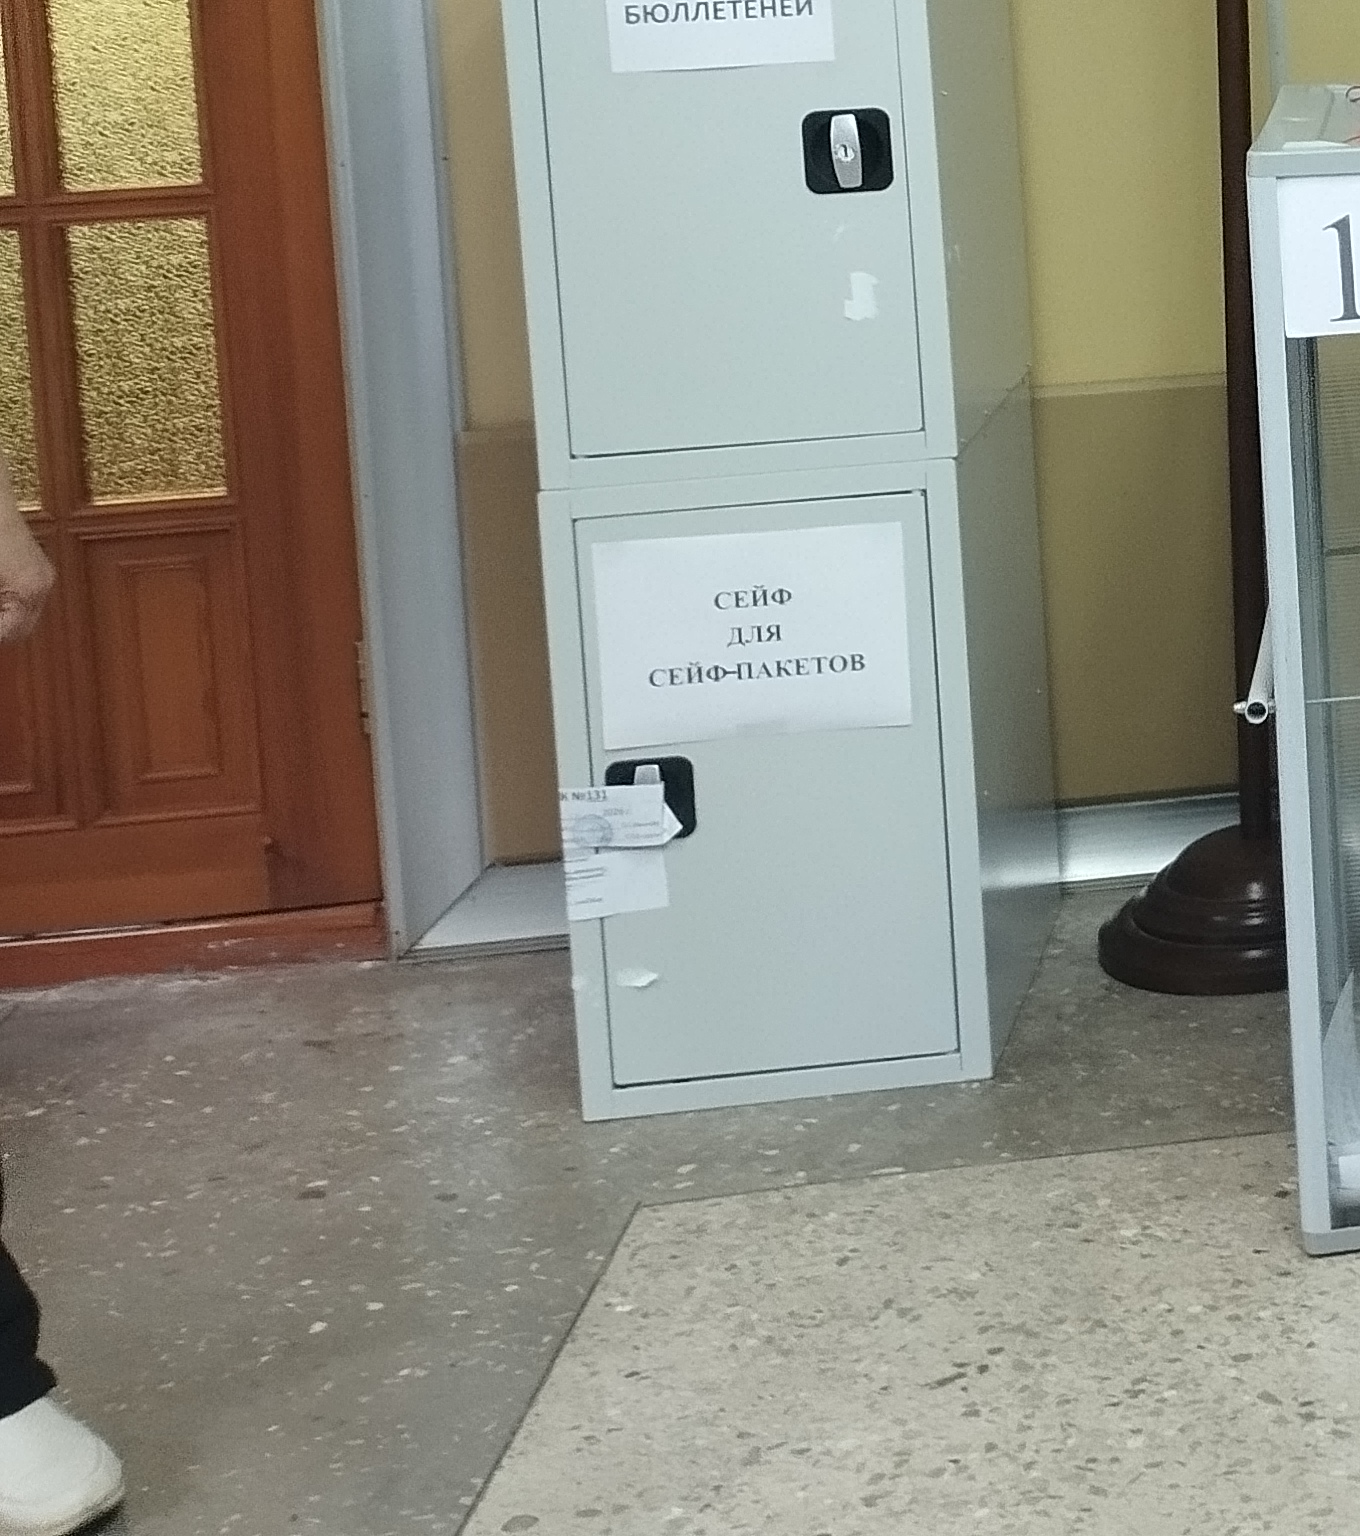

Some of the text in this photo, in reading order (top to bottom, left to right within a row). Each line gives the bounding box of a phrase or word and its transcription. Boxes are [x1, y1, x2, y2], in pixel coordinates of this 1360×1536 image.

[713, 584, 793, 611] СЕЙФ
[726, 623, 783, 647] ДЛЯ
[648, 652, 866, 689] СЕЙФ-ПАКЕТОВ
